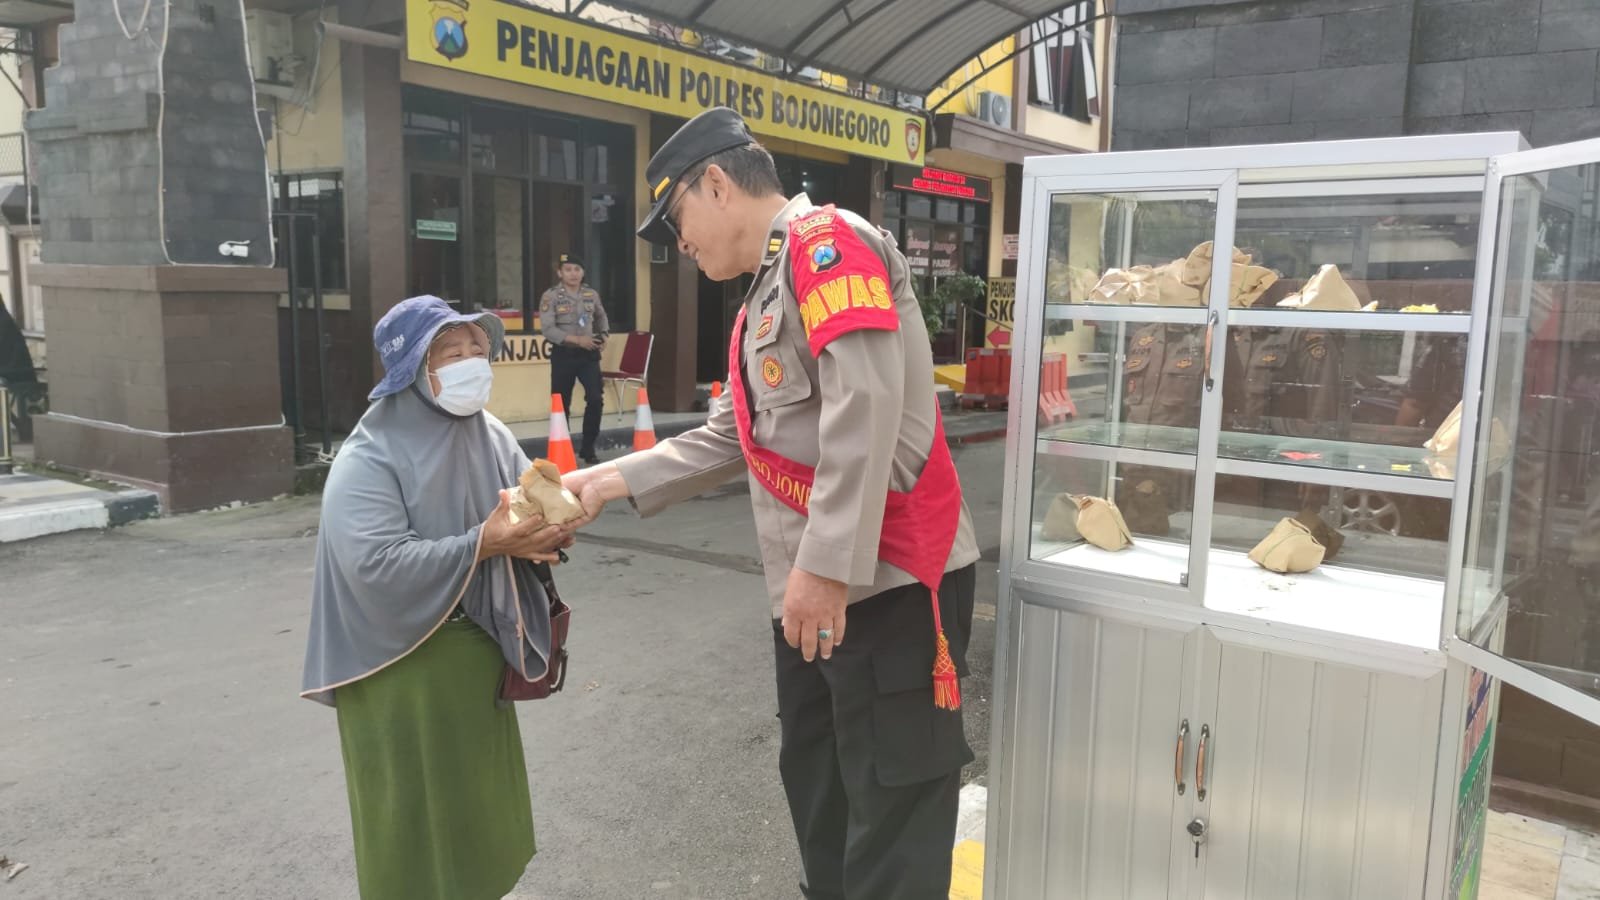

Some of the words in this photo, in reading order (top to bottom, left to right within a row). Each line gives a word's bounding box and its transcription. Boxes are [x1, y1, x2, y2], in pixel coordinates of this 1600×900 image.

[496, 19, 671, 99] PENJAGAAN
[680, 66, 764, 120] POLRES
[771, 91, 891, 147] BOJONEGORO
[799, 274, 892, 339] PAWAS
[492, 338, 553, 362] NJAG
